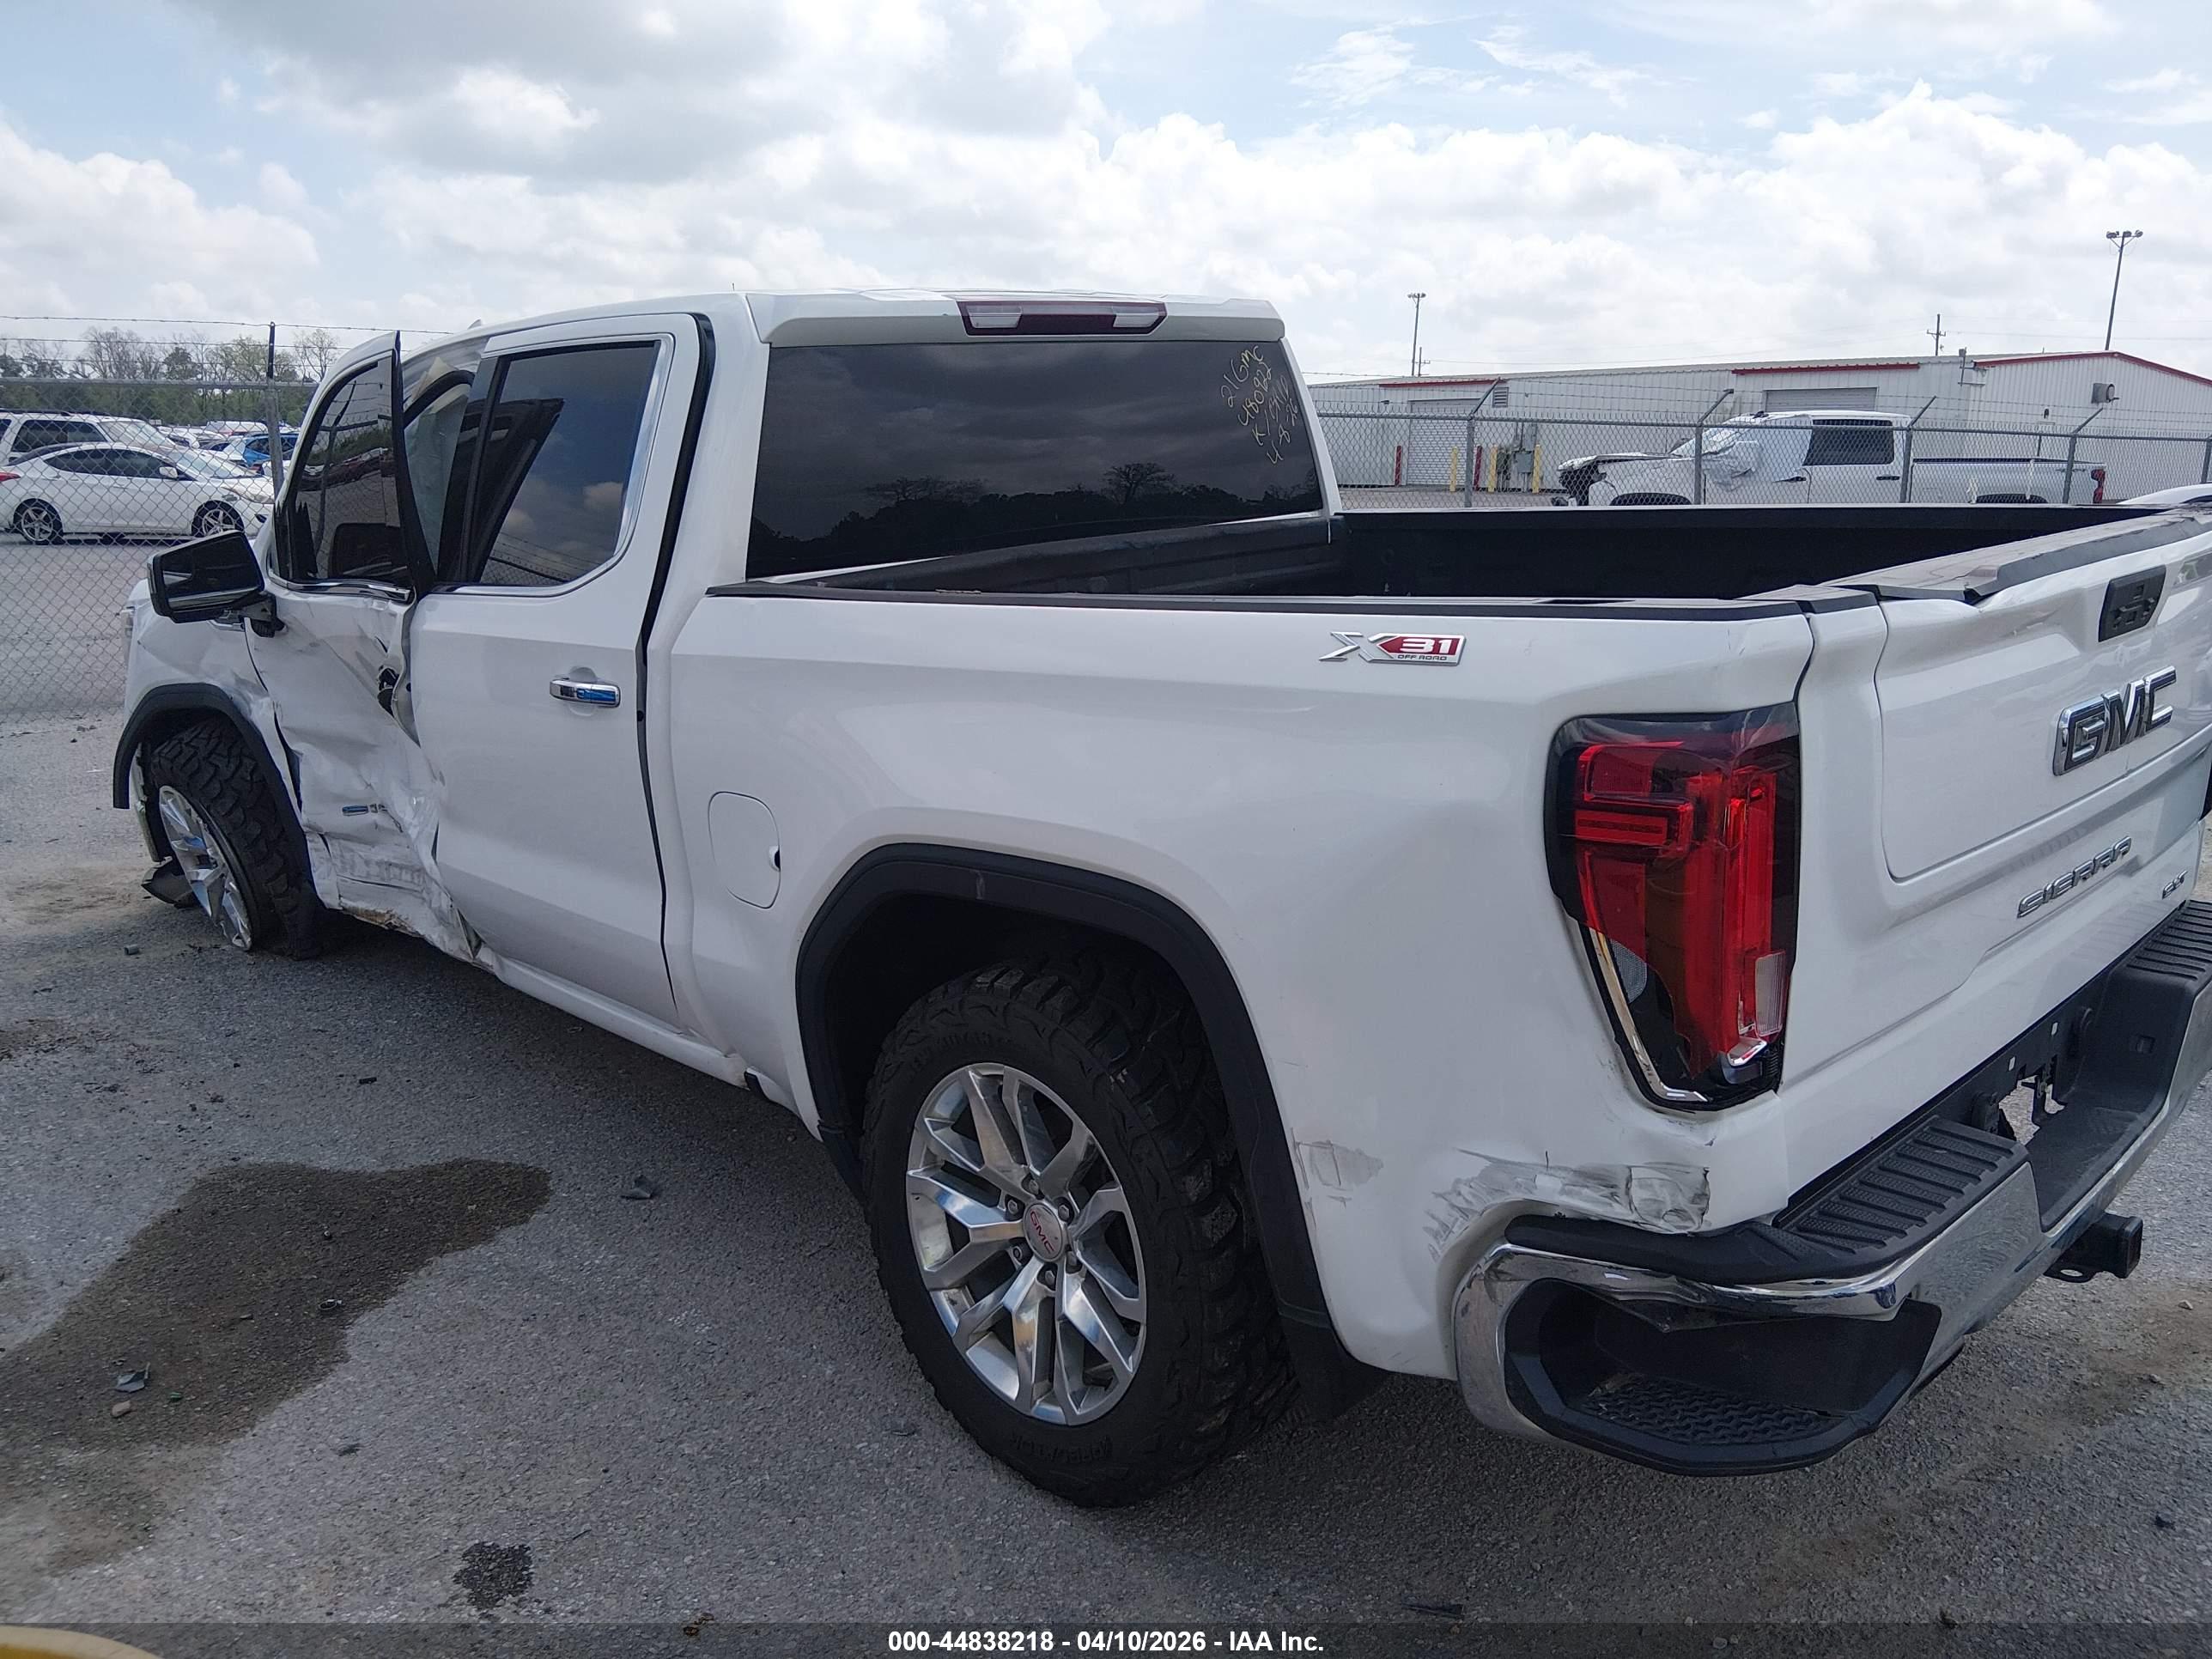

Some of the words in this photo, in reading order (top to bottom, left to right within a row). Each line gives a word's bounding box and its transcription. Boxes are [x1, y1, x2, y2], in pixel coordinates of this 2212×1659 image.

[2051, 665, 2177, 776] GMC
[2017, 836, 2132, 919] SIERRA
[1030, 1211, 1054, 1254] GMC
